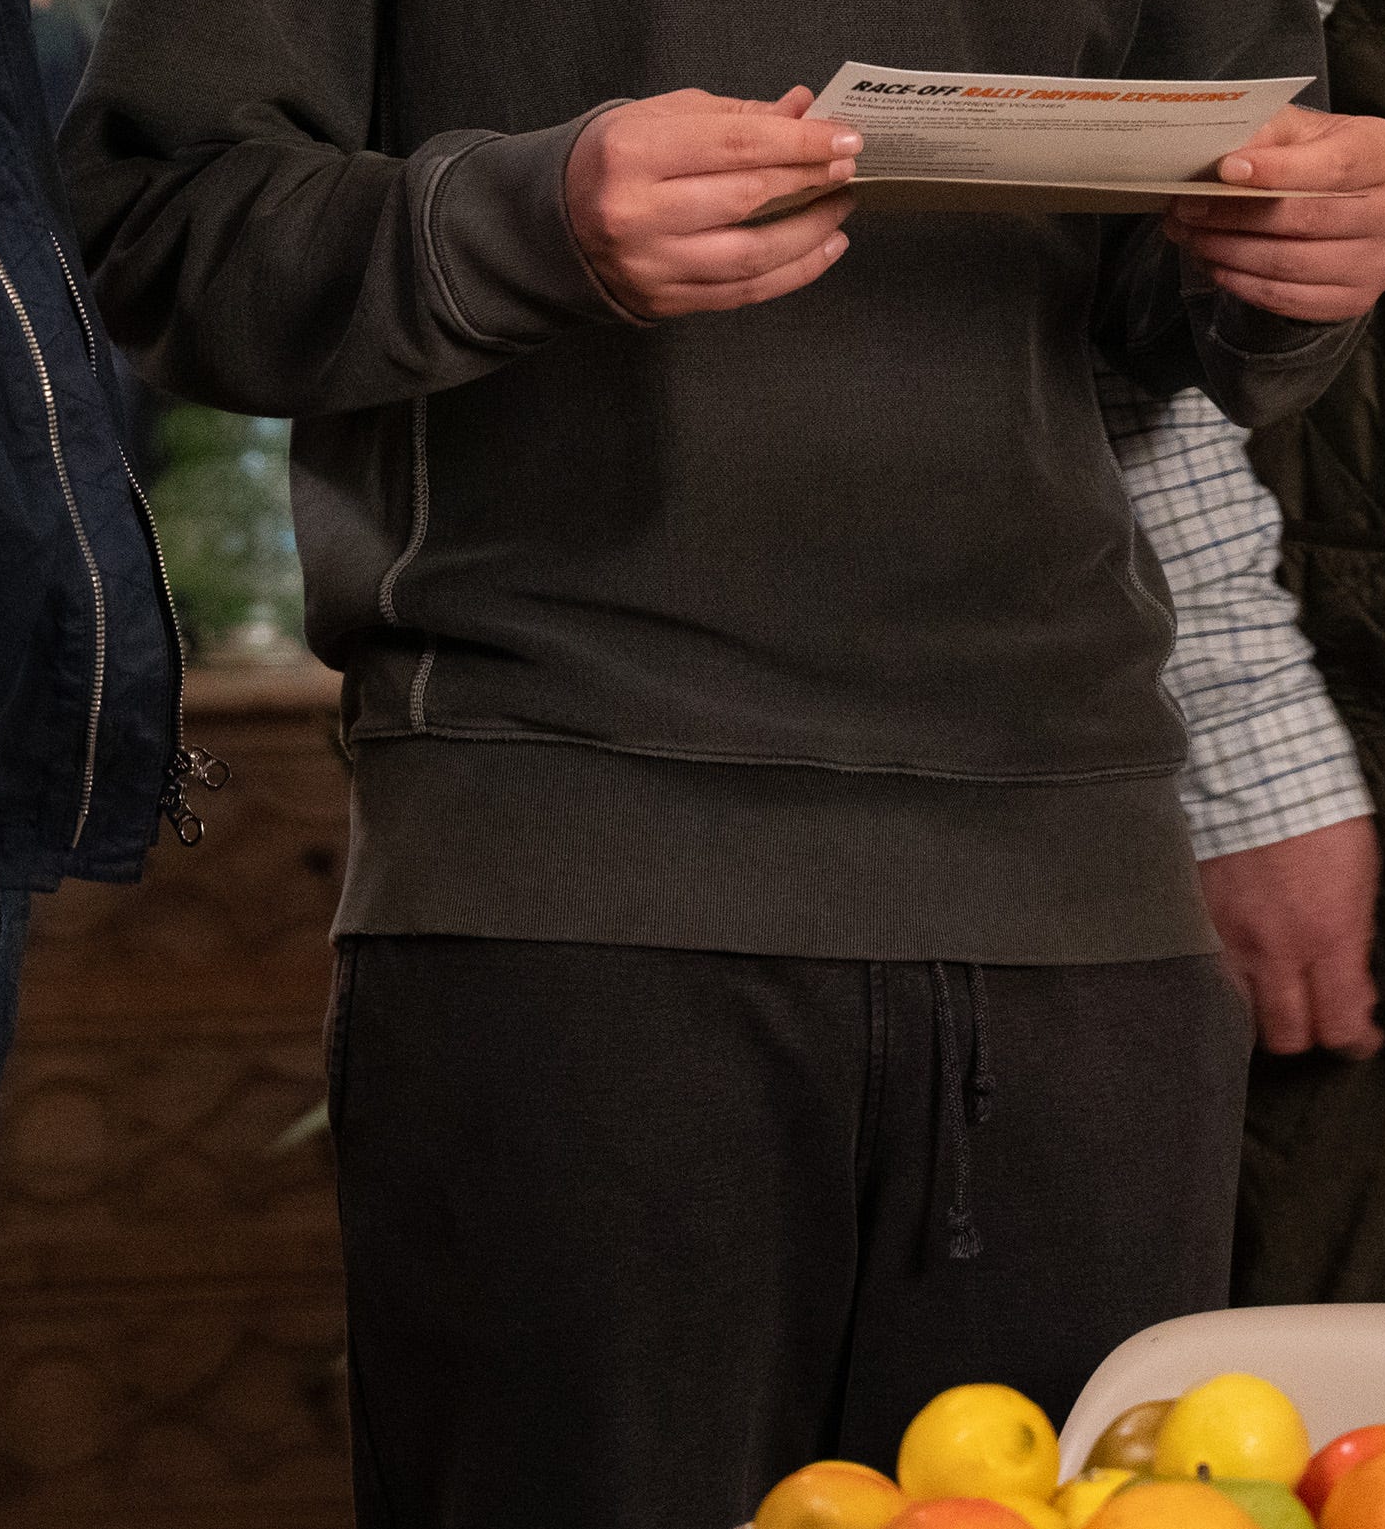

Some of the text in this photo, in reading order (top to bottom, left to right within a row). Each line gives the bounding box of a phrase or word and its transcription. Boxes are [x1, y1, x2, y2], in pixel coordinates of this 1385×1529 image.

[851, 80, 1250, 103] RACE-OFF RALLY DRIVING EXPERIENCE
